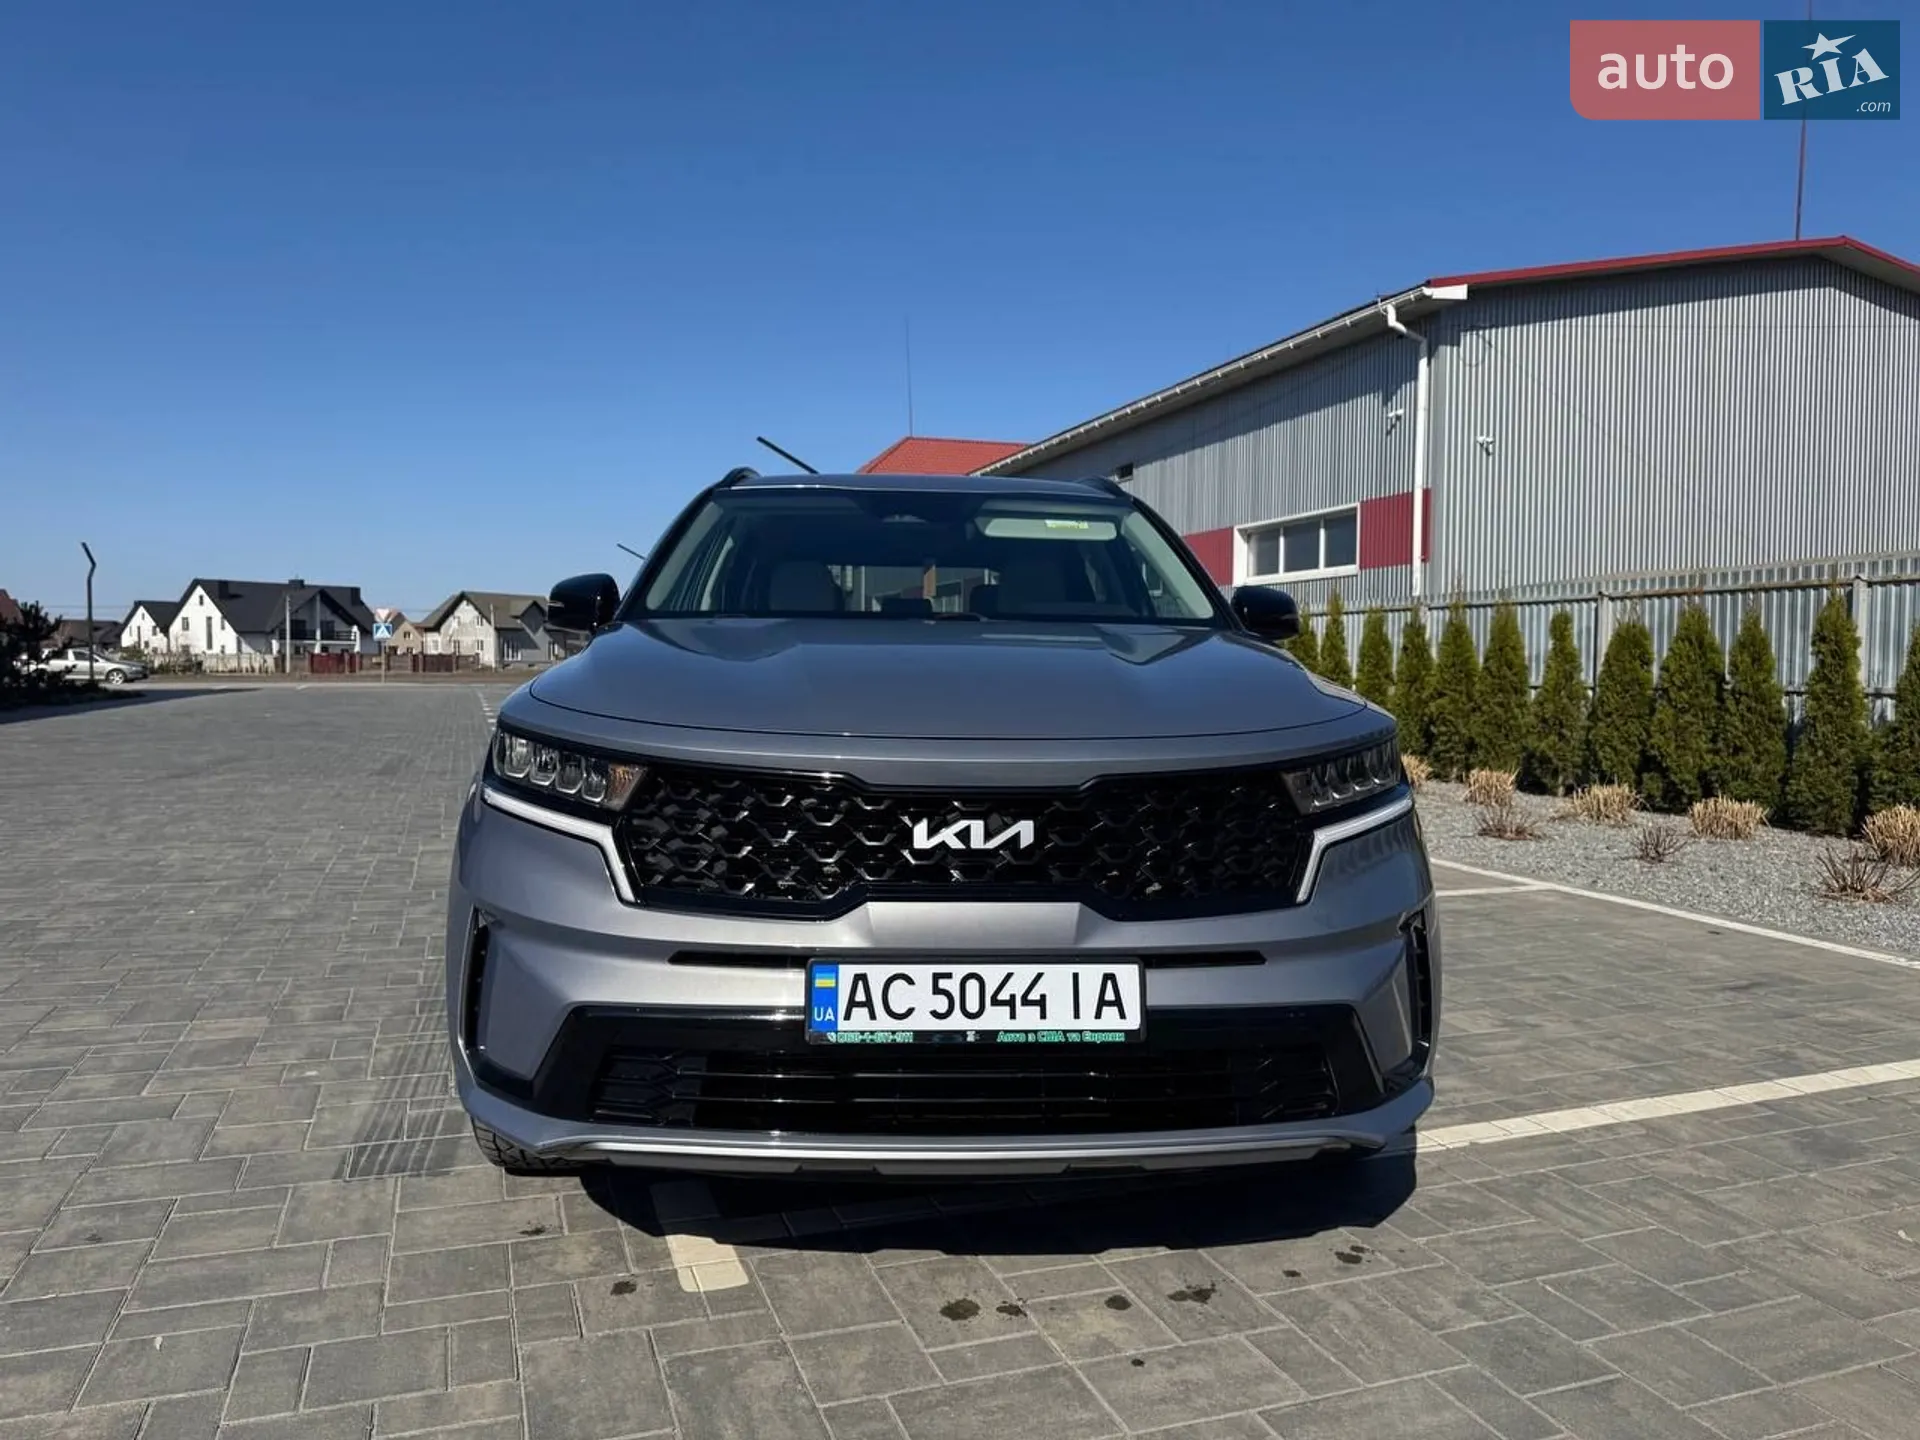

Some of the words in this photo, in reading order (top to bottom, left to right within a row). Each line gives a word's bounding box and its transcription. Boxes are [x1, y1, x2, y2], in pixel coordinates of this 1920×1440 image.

[913, 818, 1035, 849] KIA
[843, 972, 916, 1021] AC
[929, 972, 1047, 1020] 5044
[1072, 972, 1127, 1021] IA
[814, 1006, 835, 1021] UA
